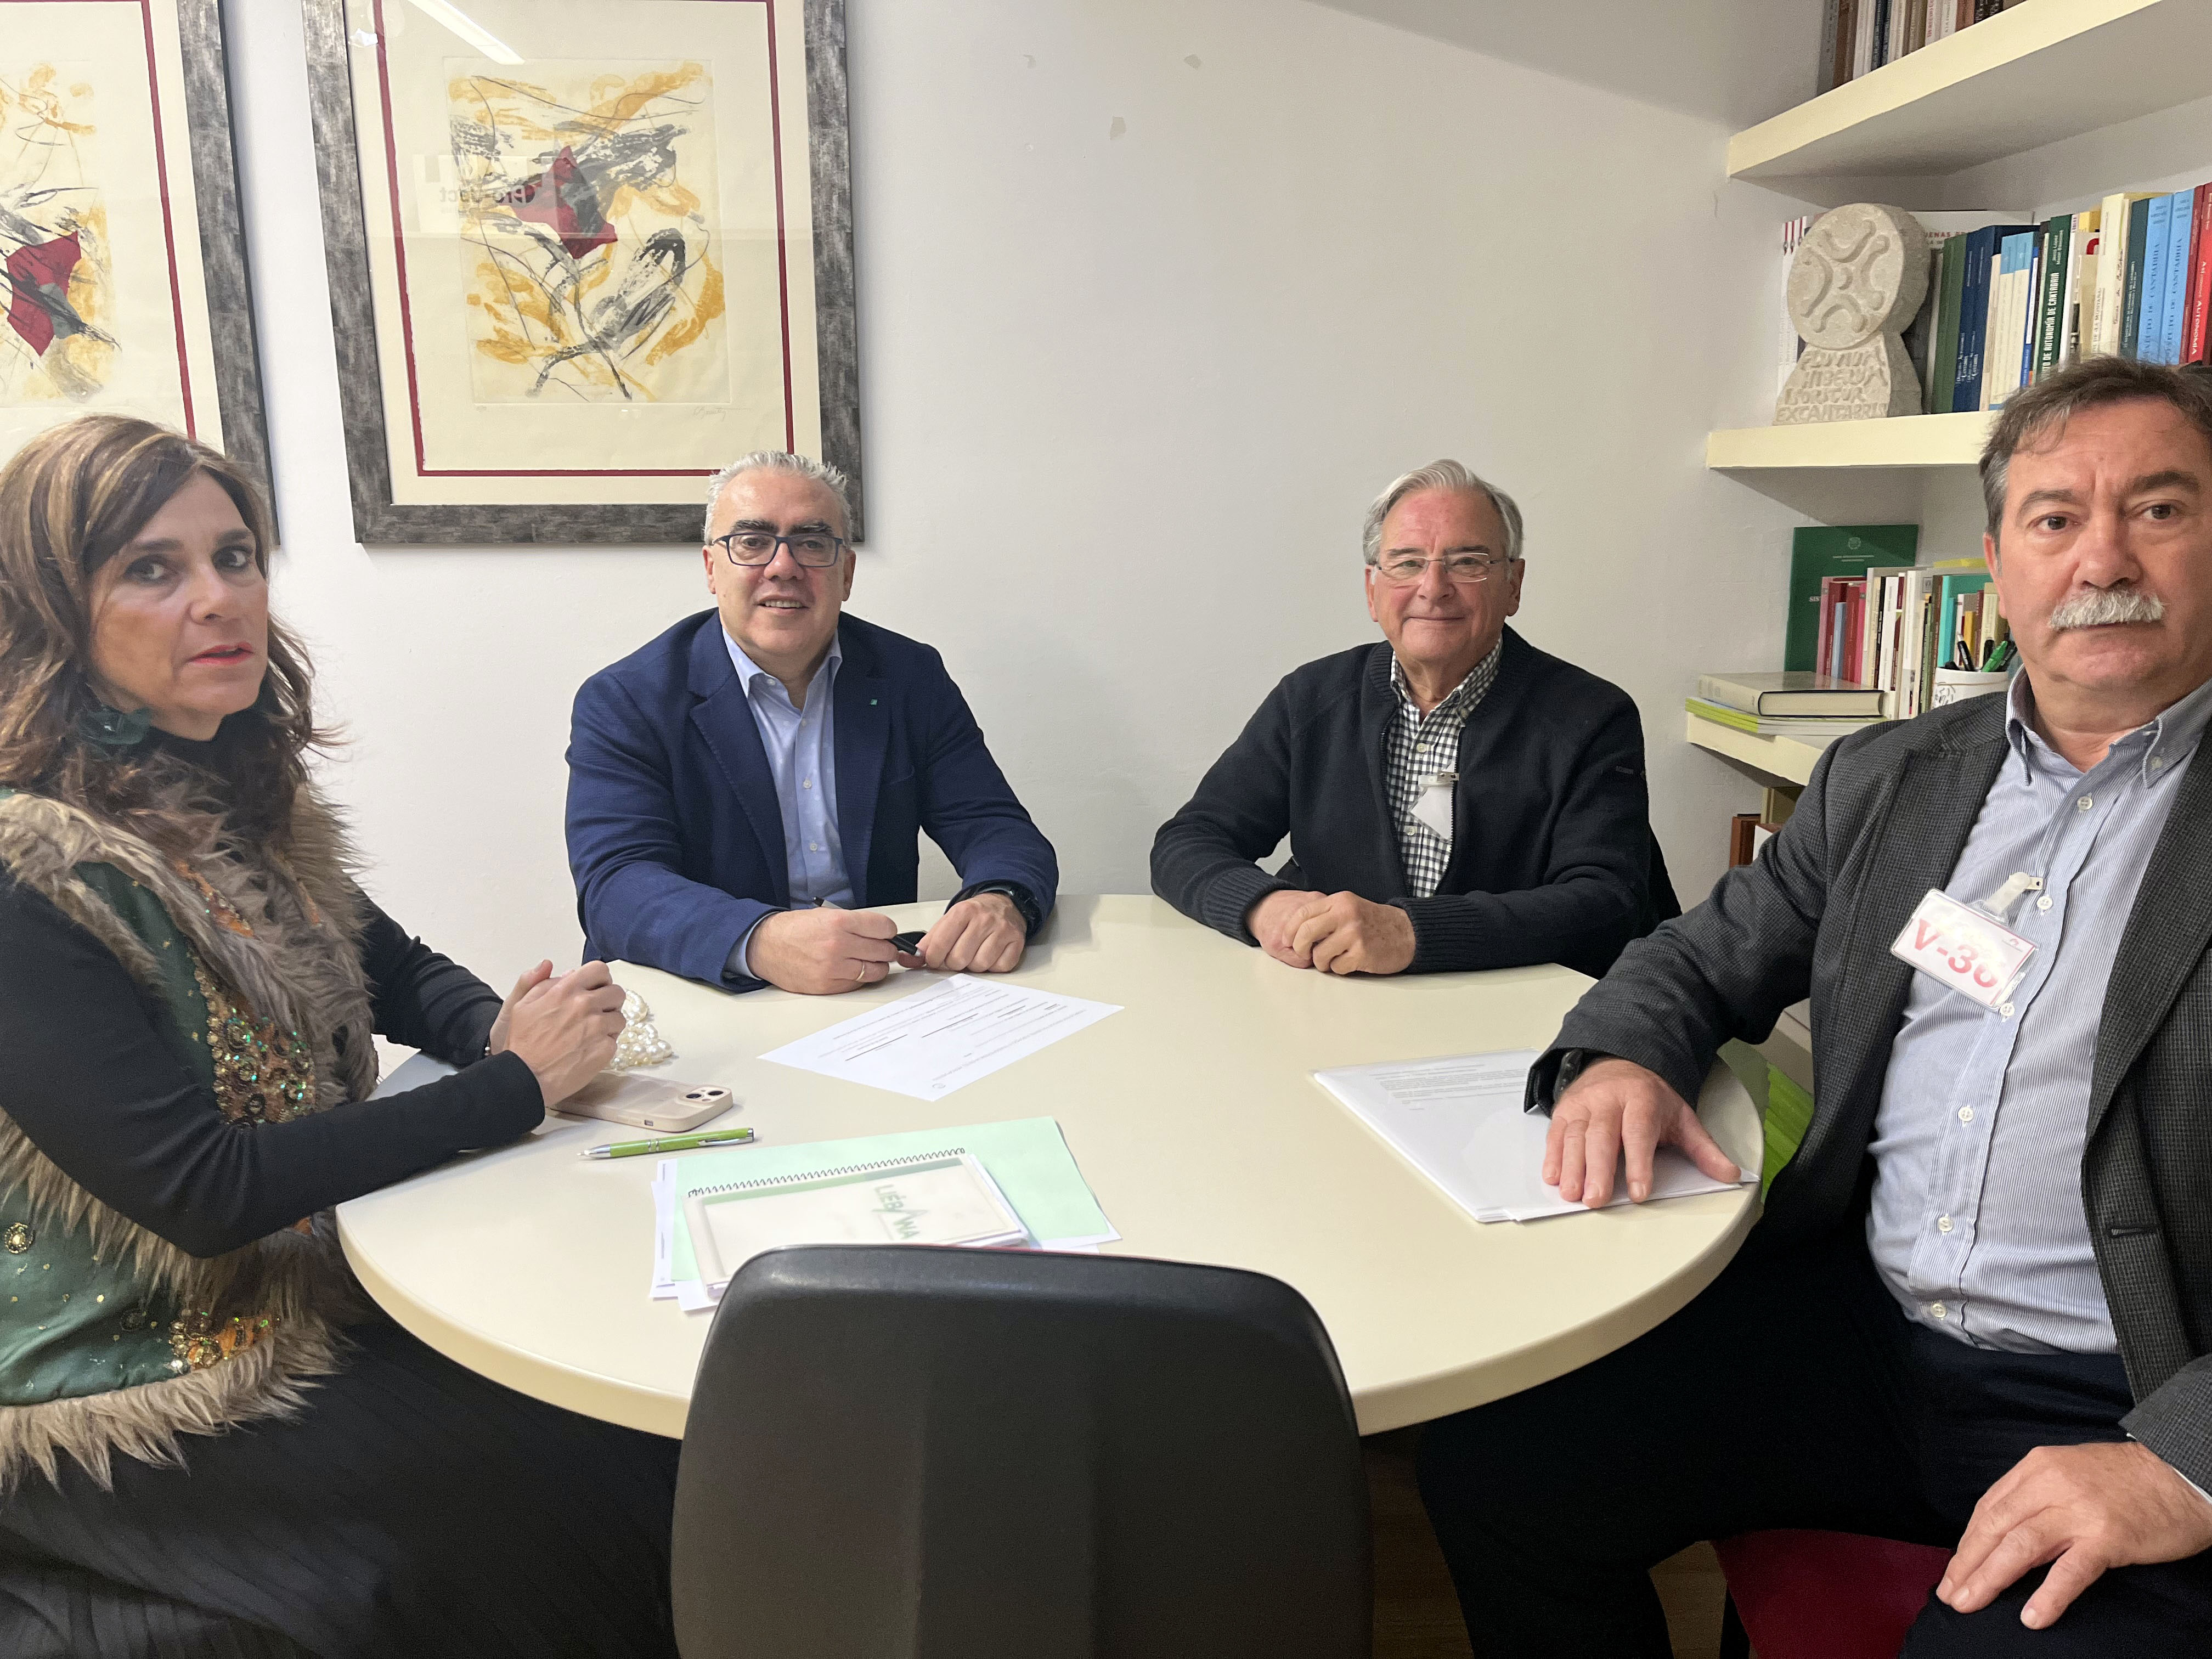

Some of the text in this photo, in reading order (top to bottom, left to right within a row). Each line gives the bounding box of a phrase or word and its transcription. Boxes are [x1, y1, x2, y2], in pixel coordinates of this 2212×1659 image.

[2149, 242, 2160, 297] CANTABRIA
[2171, 238, 2182, 294] CANTABRIA
[2043, 352, 2052, 360] DE
[2048, 272, 2059, 306] CANTABRIA
